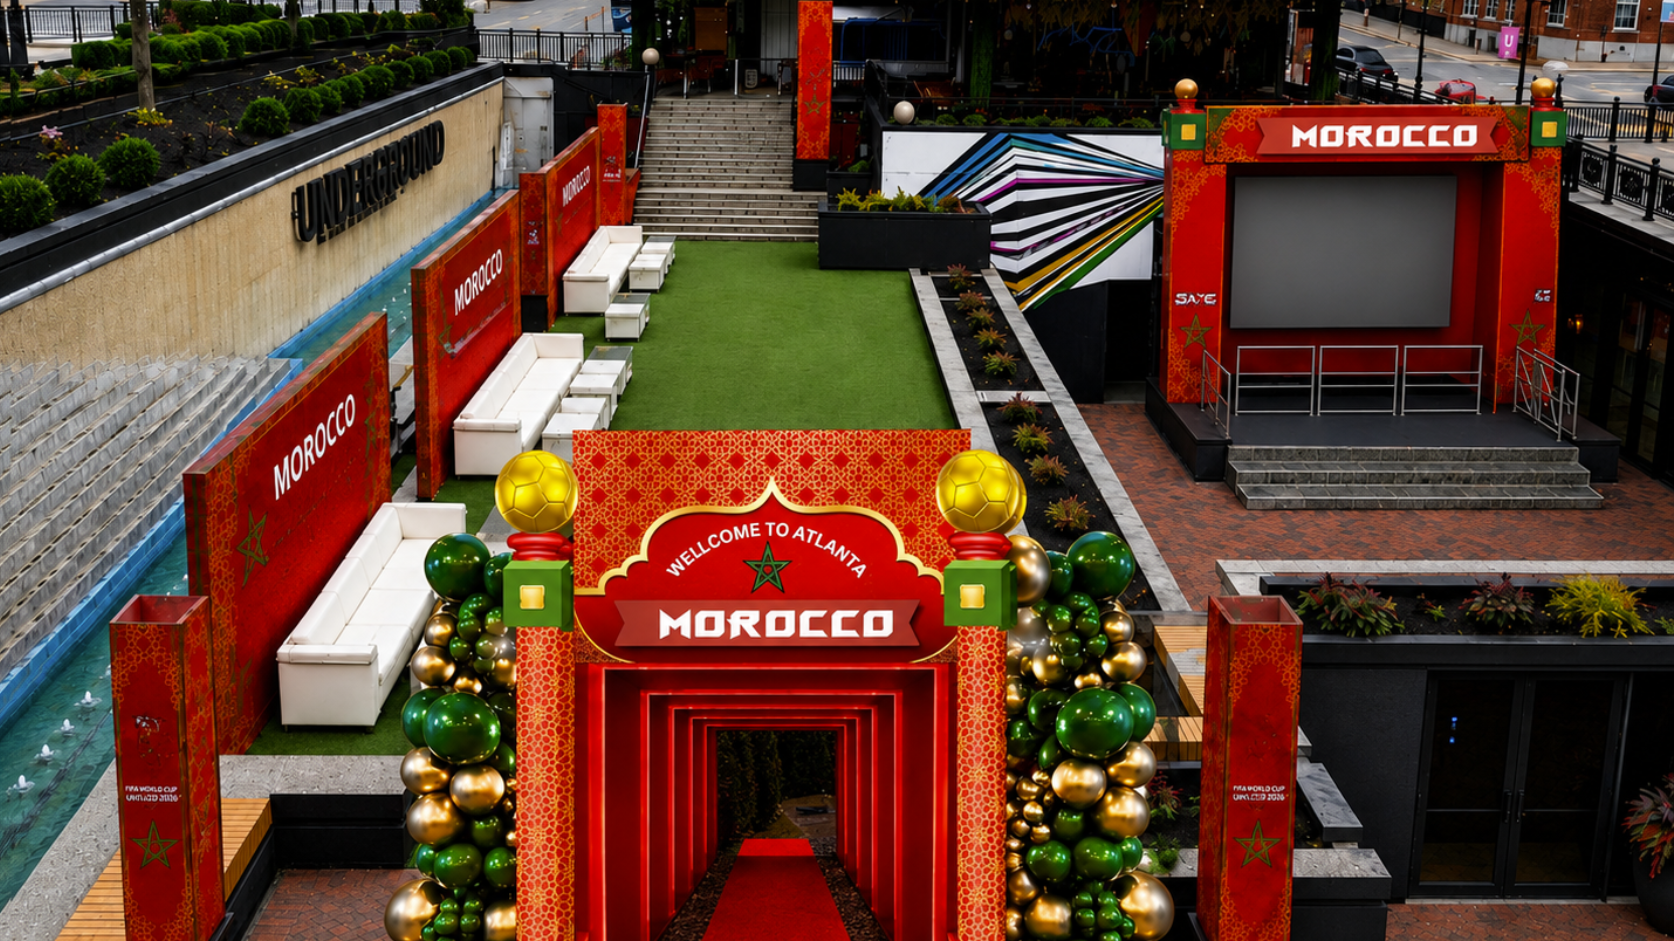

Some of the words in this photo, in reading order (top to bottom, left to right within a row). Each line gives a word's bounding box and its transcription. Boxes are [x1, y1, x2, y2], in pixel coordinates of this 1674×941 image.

[1504, 34, 1514, 48] U
[1292, 124, 1478, 149] MOROCCO
[291, 120, 445, 244] UNDERGROUND
[562, 165, 591, 207] MOROCCO
[454, 248, 503, 316] MOROCCO
[273, 393, 356, 501] MOROCCO
[665, 522, 761, 577] WELLCOME
[765, 521, 789, 537] TO
[791, 526, 867, 579] ATLANTA
[659, 609, 894, 640] MOROCCO
